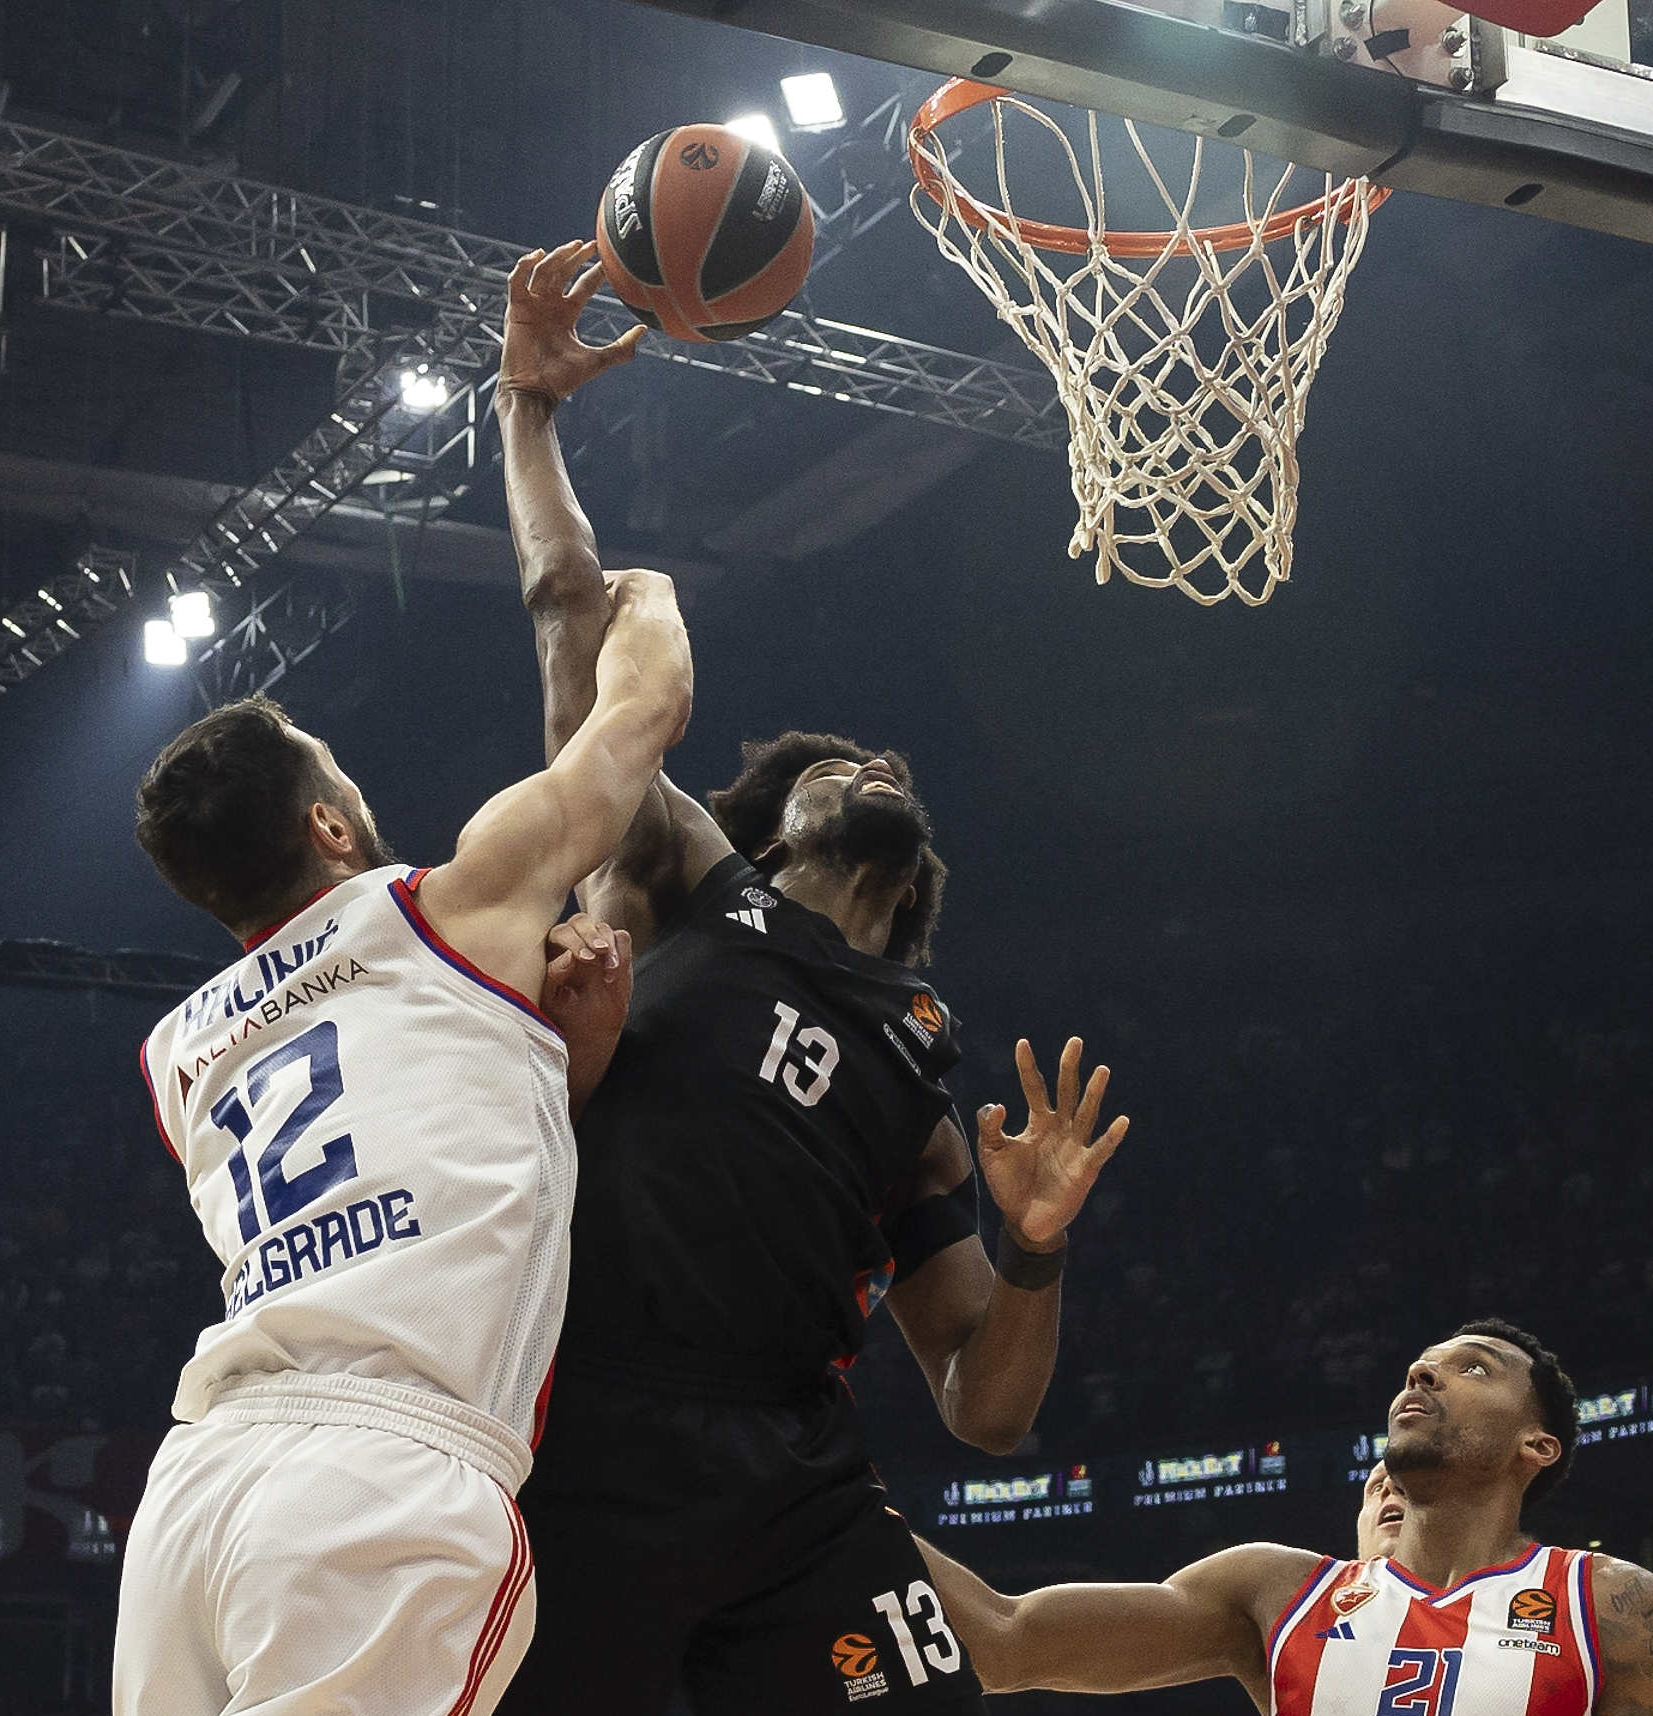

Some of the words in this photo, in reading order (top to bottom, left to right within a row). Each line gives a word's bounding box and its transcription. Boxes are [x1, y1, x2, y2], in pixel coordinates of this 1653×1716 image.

[758, 1001, 840, 1107] 13
[210, 1020, 359, 1246] 12
[871, 1580, 962, 1687] 13
